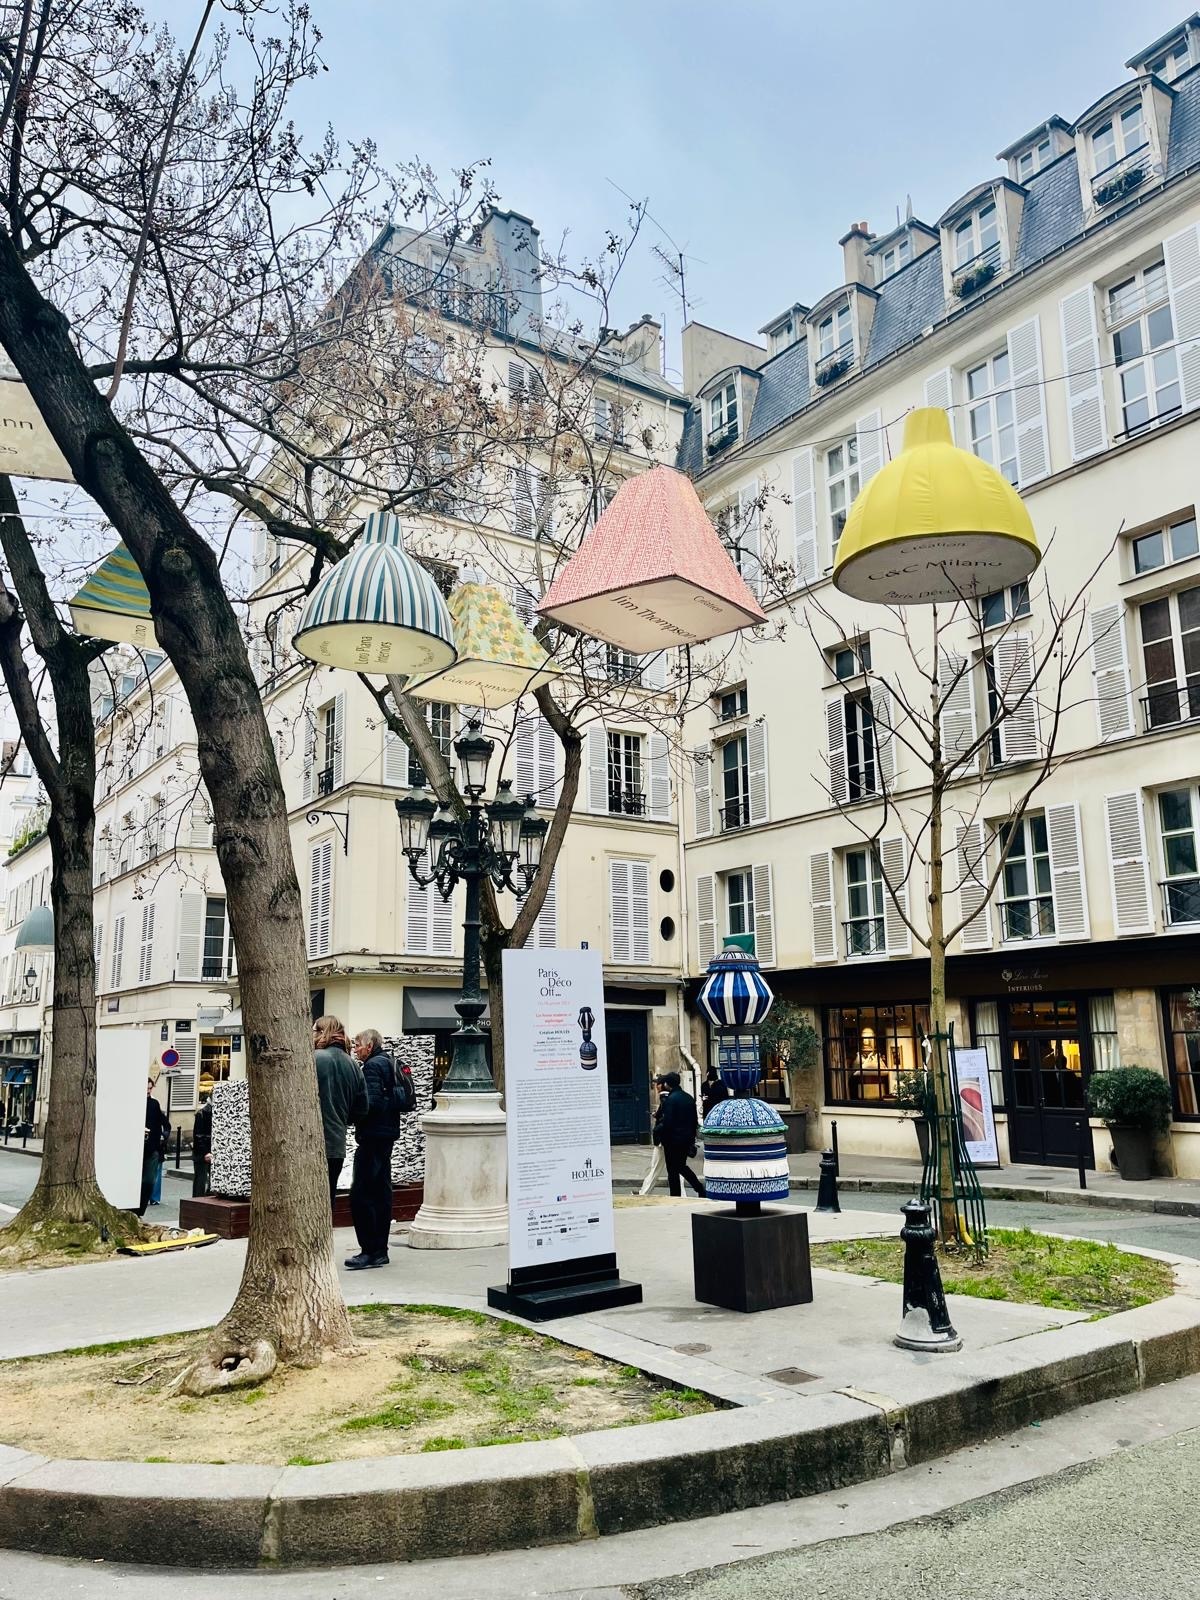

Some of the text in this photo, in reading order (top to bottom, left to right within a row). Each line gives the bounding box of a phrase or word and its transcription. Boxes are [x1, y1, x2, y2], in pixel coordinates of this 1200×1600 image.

[868, 559, 1002, 580] C&C Milano
[610, 595, 639, 611] Jim
[636, 608, 697, 638] Thompson
[538, 968, 559, 978] Paris
[548, 977, 572, 987] Déco
